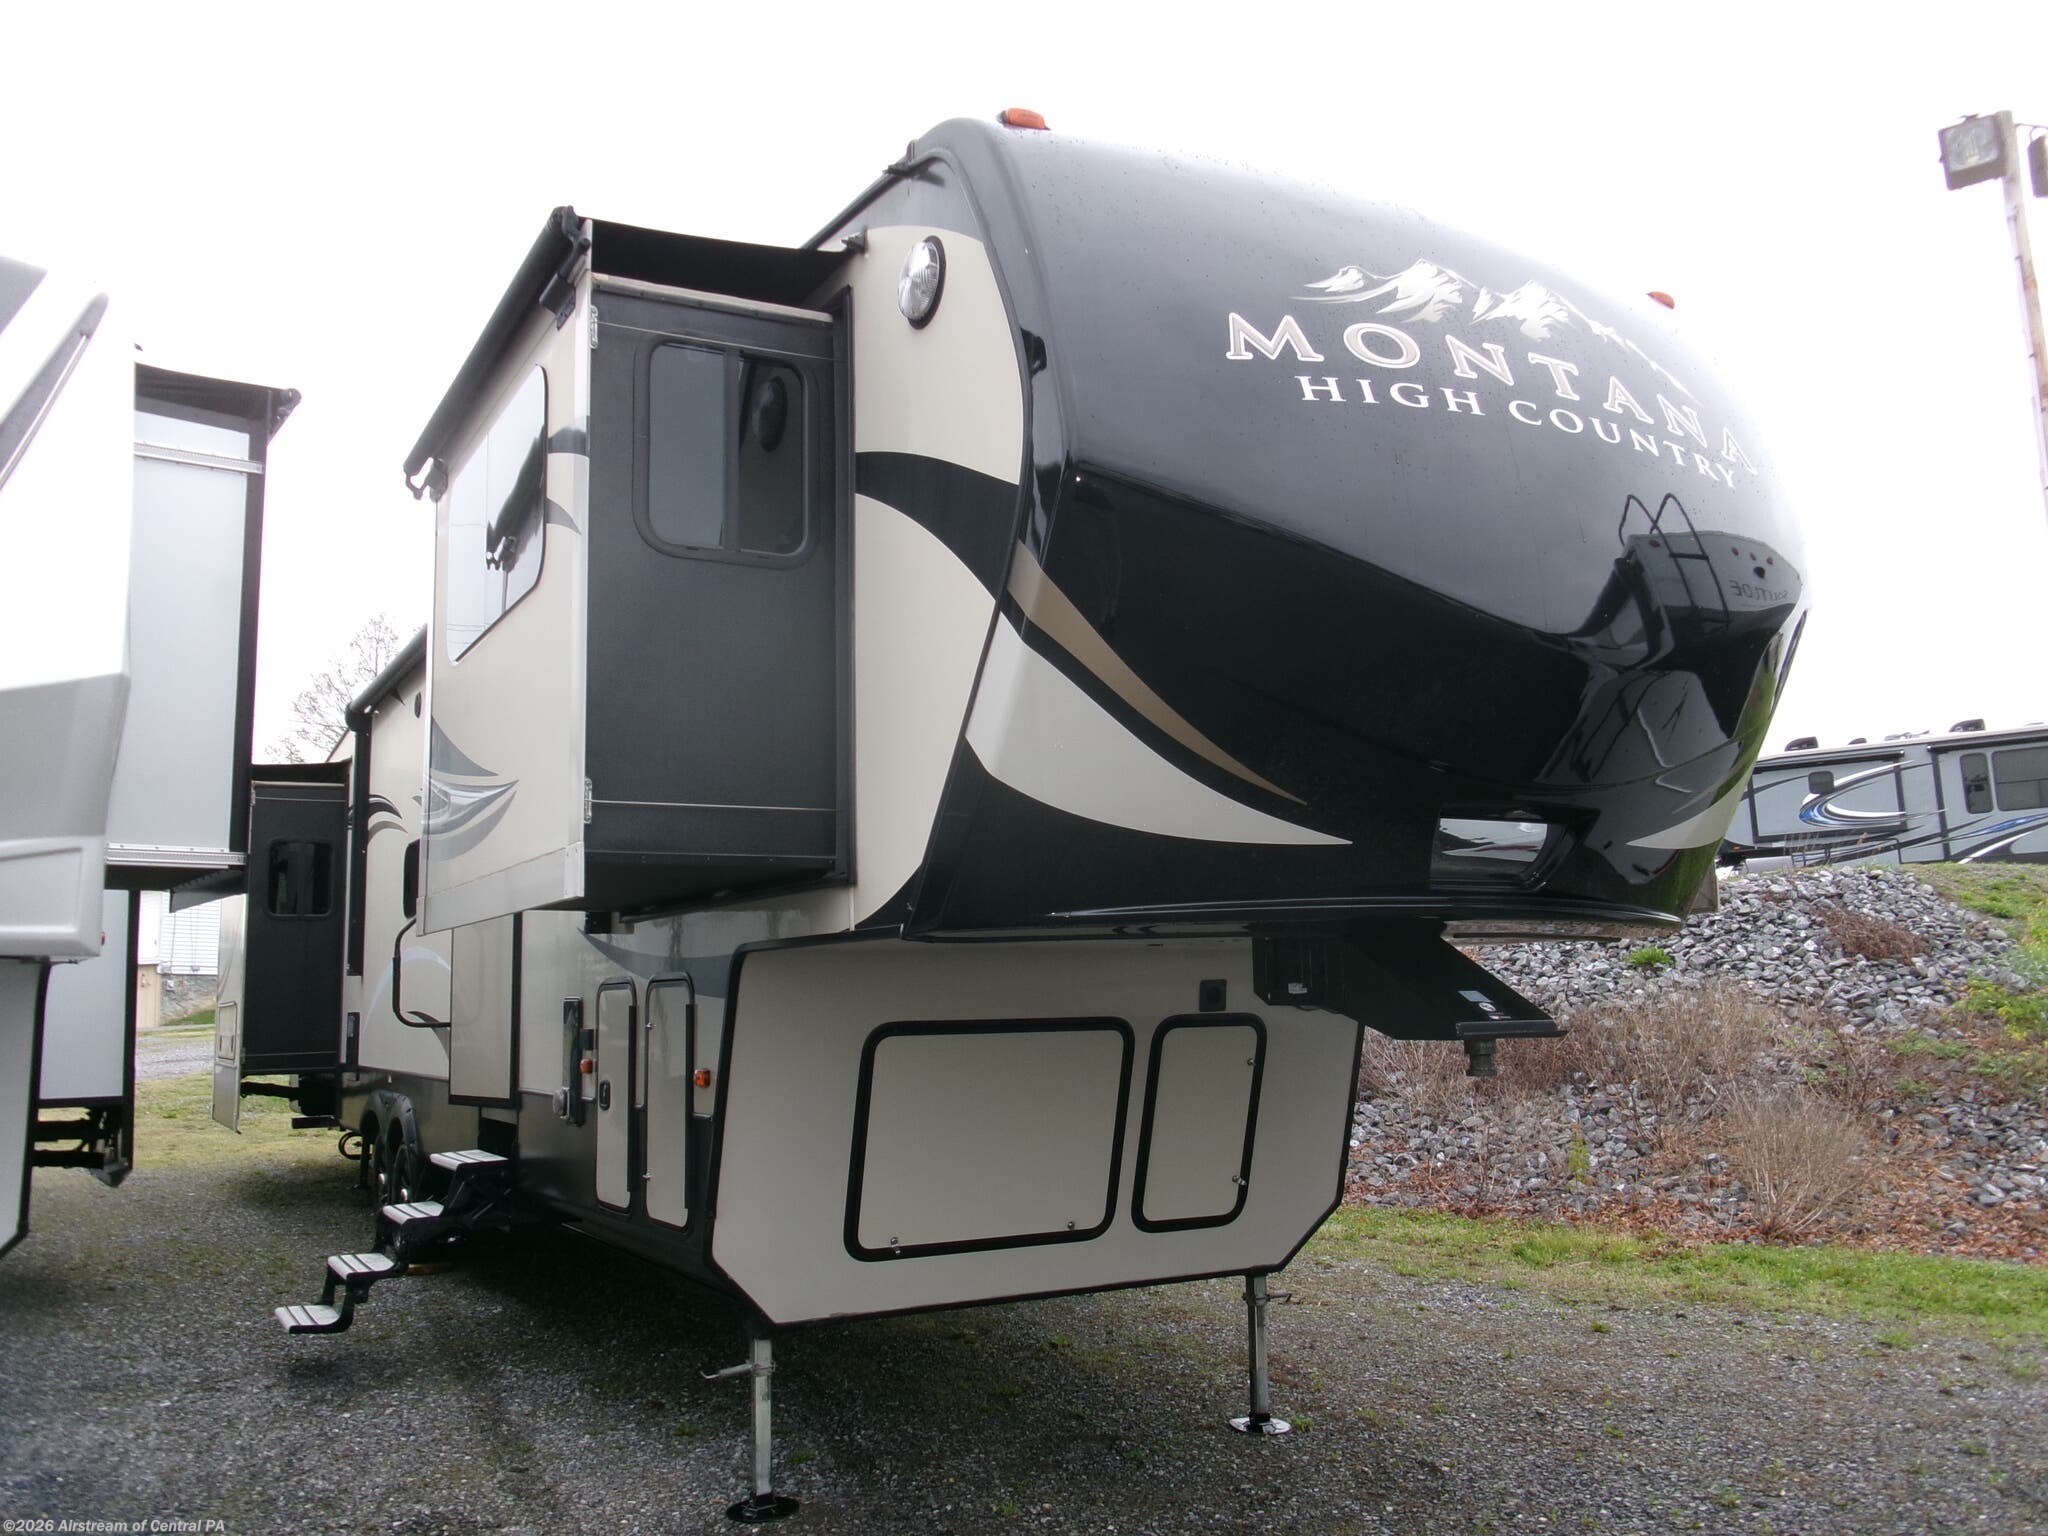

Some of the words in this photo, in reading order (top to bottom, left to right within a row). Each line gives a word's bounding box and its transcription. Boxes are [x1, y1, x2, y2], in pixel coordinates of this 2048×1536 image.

[1225, 311, 1759, 475] MONTANA
[1294, 375, 1486, 416] HIGH
[1508, 400, 1738, 489] COUNTRY
